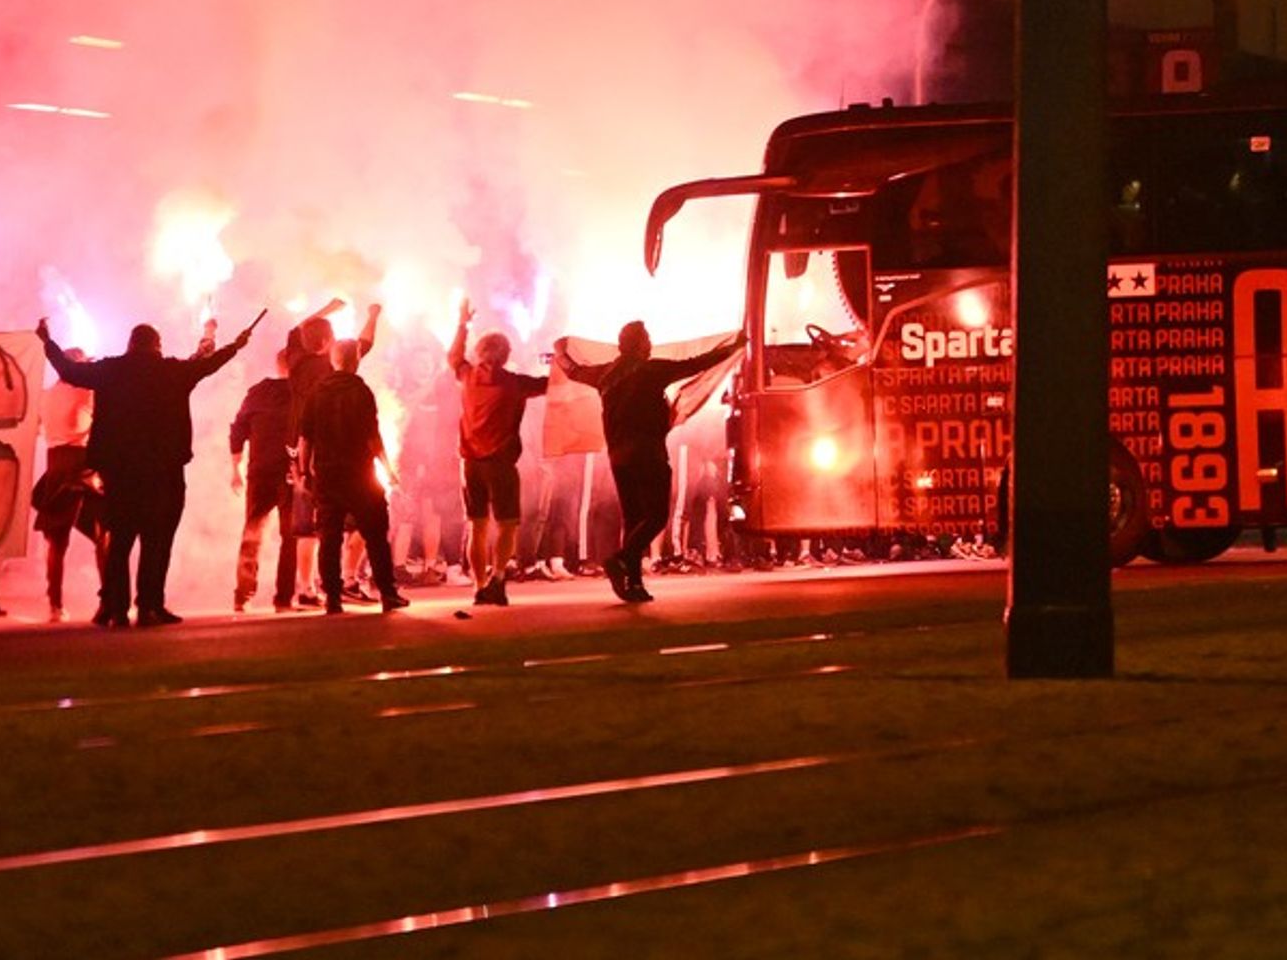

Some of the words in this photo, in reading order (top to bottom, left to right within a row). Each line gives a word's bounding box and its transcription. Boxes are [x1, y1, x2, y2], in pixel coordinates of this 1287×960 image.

[1156, 272, 1223, 295] PRAHA
[1110, 302, 1151, 324] RTA
[1154, 300, 1223, 323] PRAHA
[1110, 329, 1152, 351] RTA
[1155, 327, 1225, 350] PRAHA
[1111, 356, 1152, 379] RTA
[1156, 354, 1225, 376] PRAHA
[901, 393, 976, 415] SPARTA
[1108, 386, 1160, 408] ARTA
[1108, 411, 1161, 433] ARTA
[916, 418, 1012, 459] PRAH
[1123, 436, 1162, 457] RTA
[1168, 385, 1230, 529] 1893
[903, 468, 979, 490] SARTA
[904, 494, 980, 516] SPARTA
